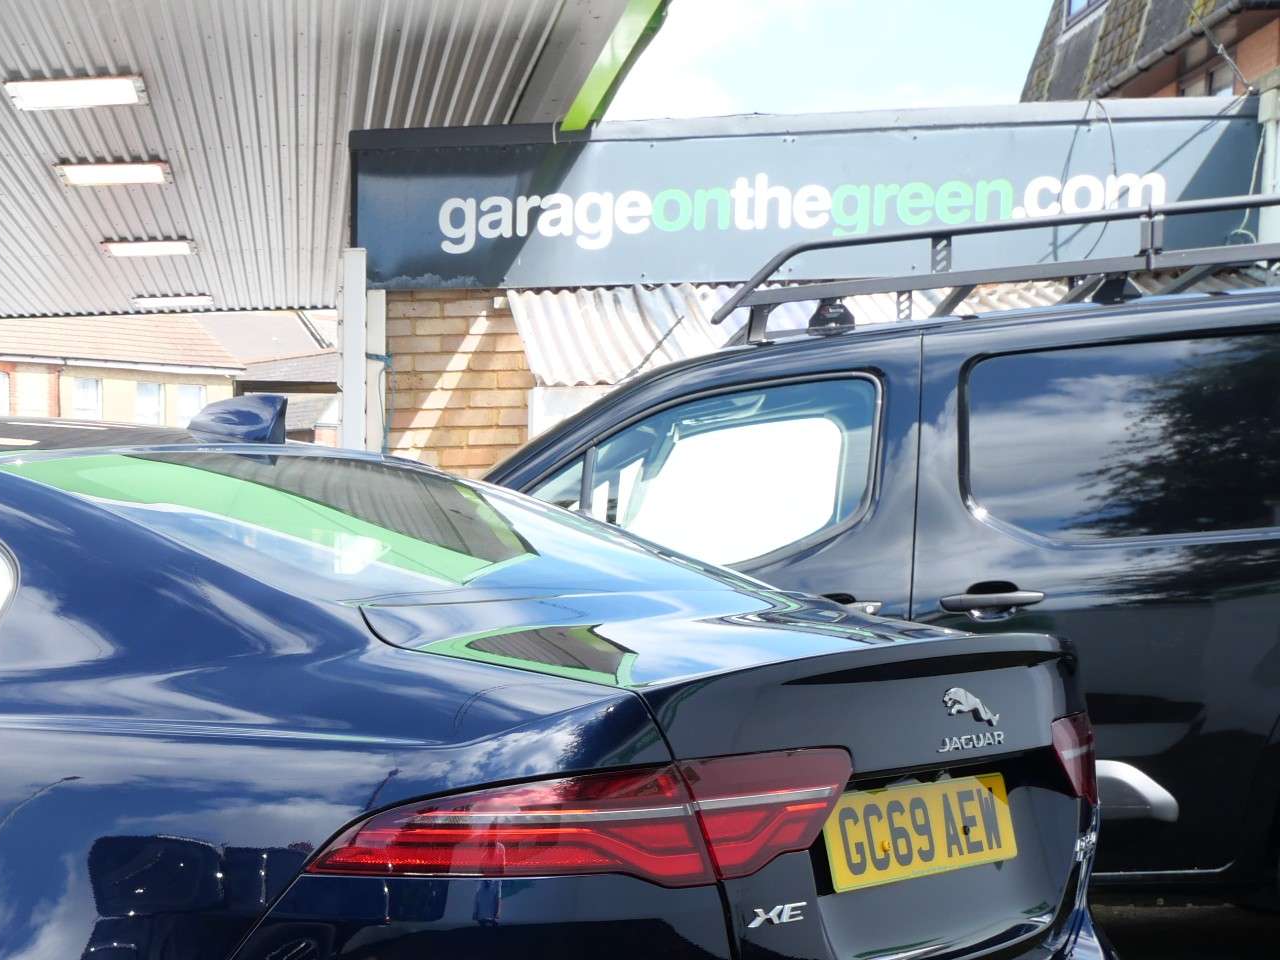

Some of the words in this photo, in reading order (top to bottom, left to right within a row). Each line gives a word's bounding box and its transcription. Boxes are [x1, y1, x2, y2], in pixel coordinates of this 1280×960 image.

[439, 171, 1166, 255] garageonthegreen.com
[938, 731, 1005, 753] JAGUAR
[838, 797, 935, 876] GC69
[943, 787, 1002, 858] AEW
[747, 901, 808, 929] XE
